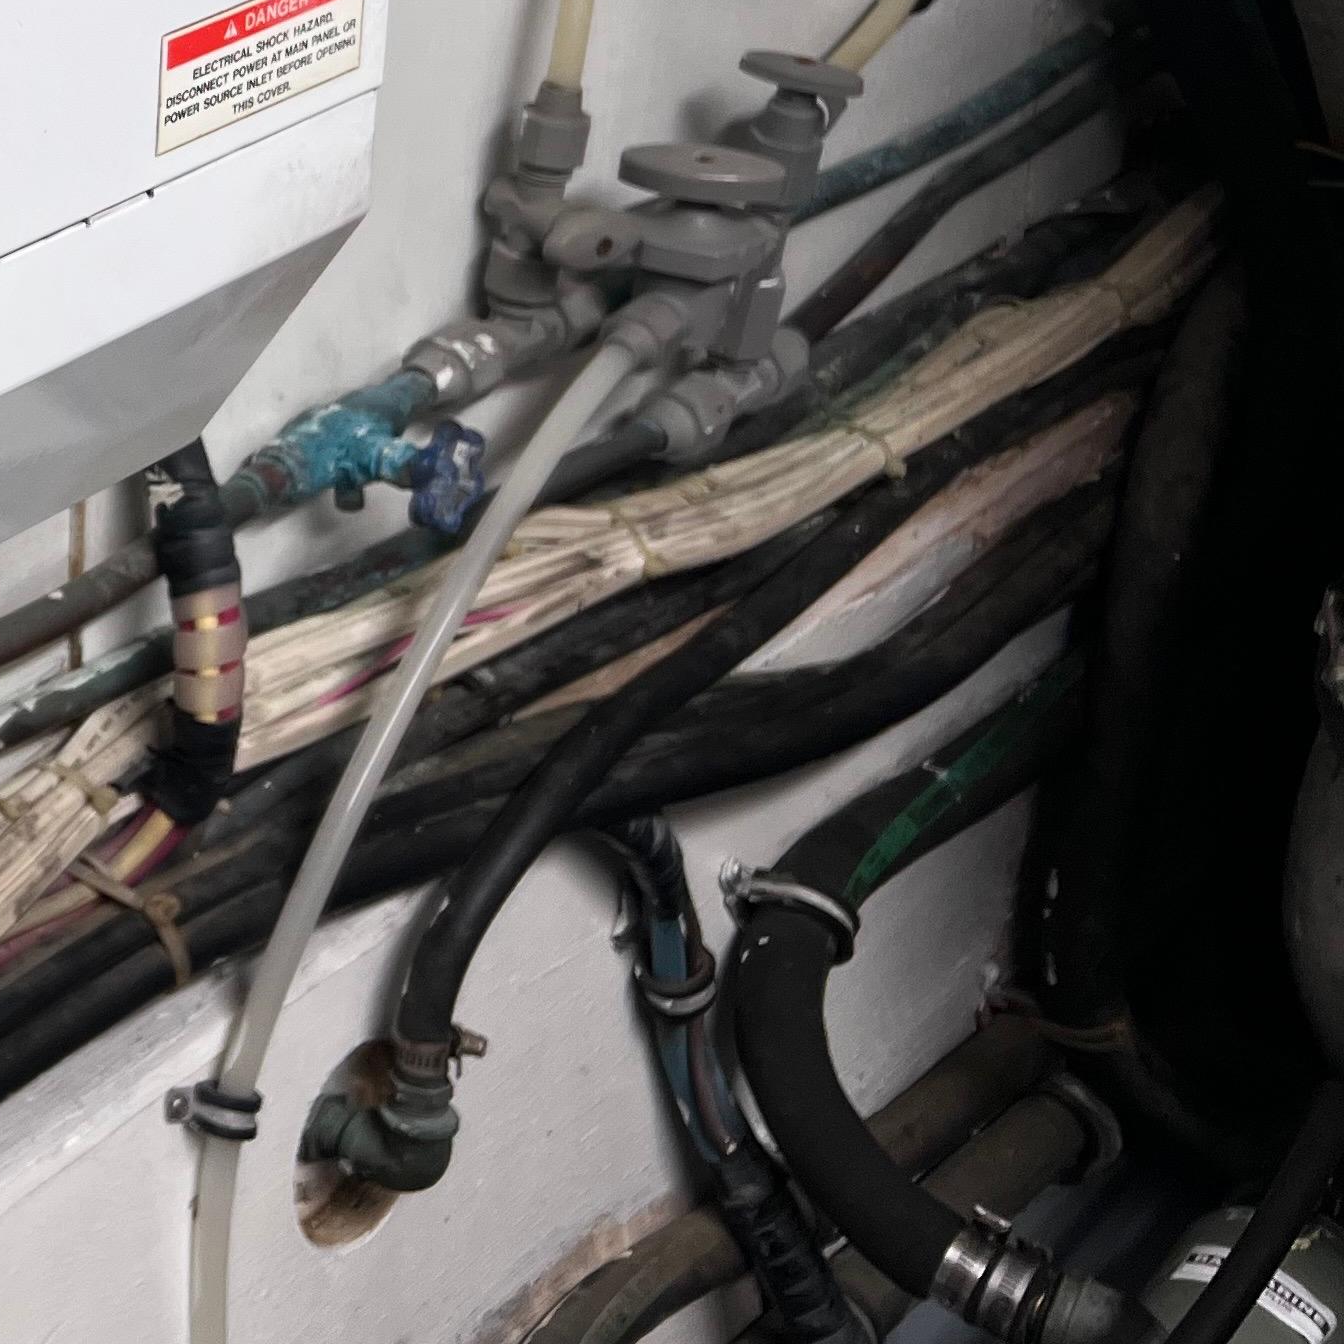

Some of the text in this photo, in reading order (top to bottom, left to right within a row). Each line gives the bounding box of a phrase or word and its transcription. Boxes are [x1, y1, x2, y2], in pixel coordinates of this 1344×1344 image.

[163, 34, 357, 127] POWER SOURCE INLET BEFORE OPENING
[165, 18, 357, 110] DISCONNECT POWER AT MAIN PANEL OR
[192, 46, 253, 81] ELECTRICAL
[255, 29, 290, 53] SHOCK
[231, 81, 292, 115] THIS COVER.
